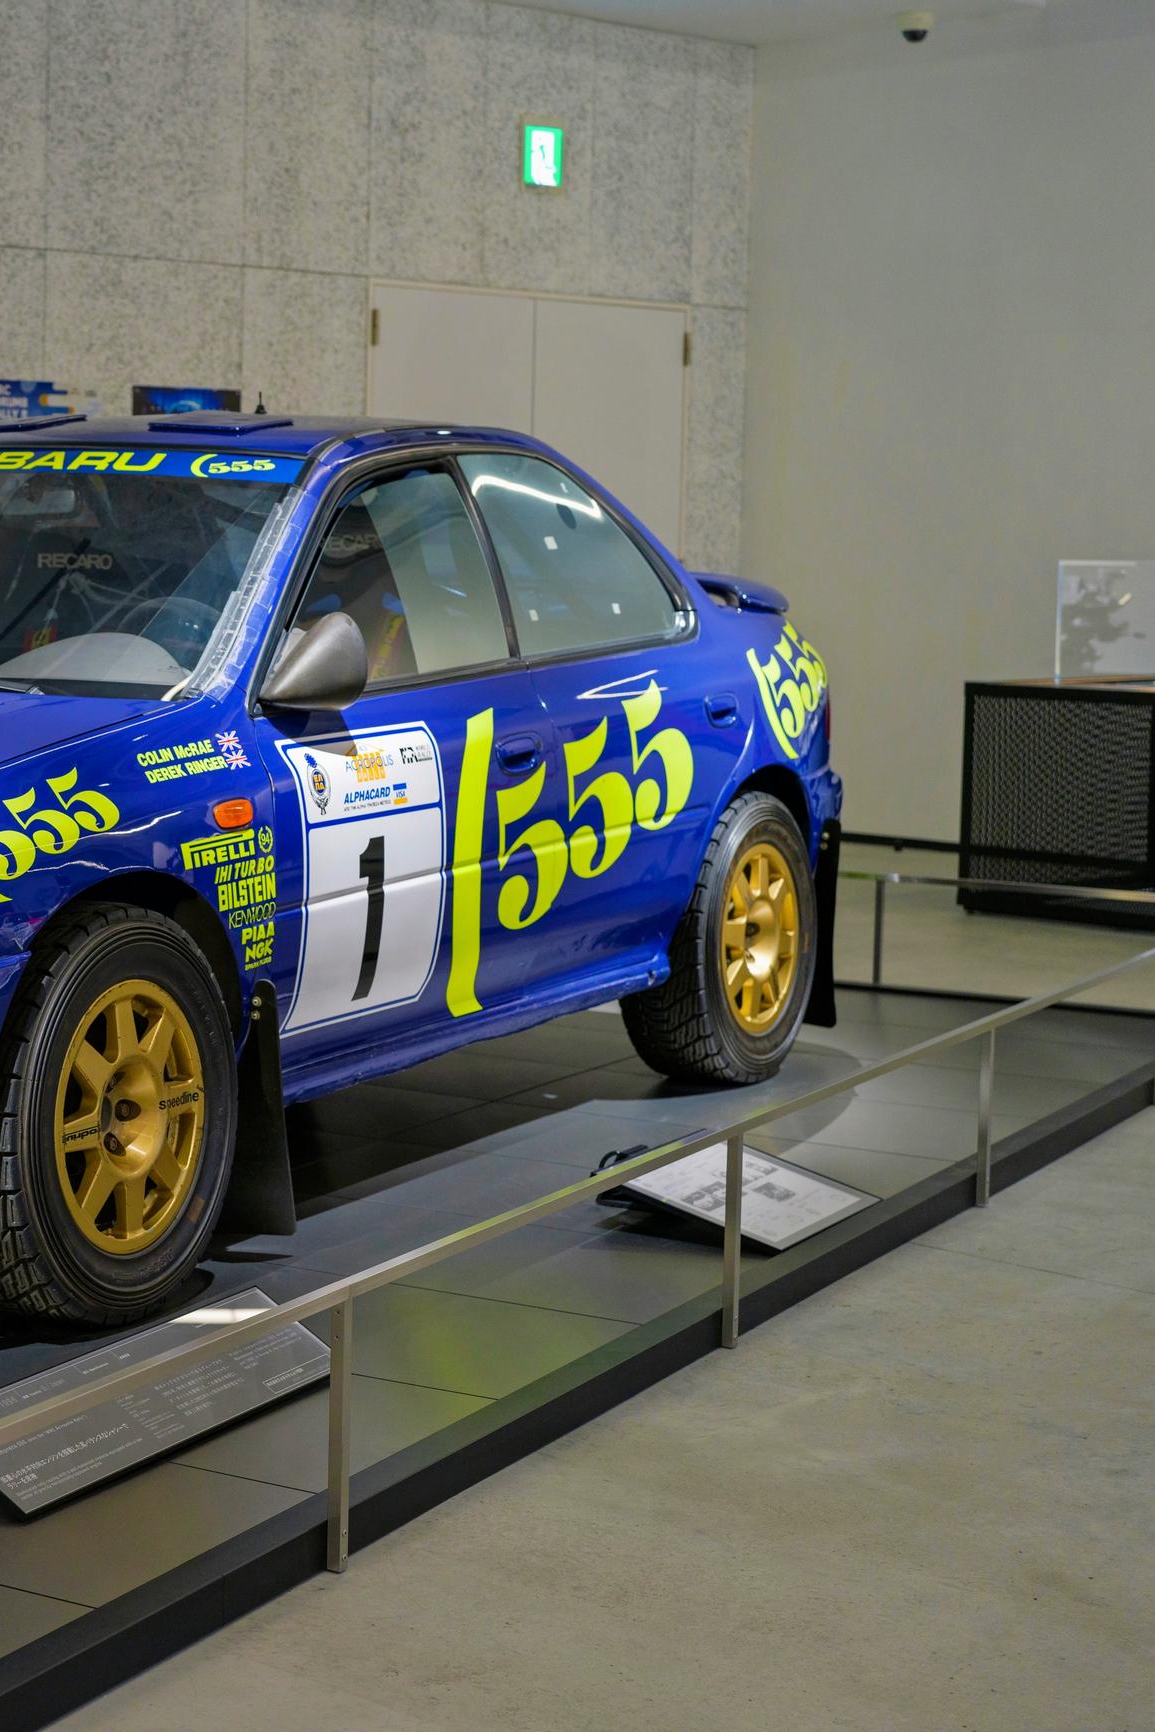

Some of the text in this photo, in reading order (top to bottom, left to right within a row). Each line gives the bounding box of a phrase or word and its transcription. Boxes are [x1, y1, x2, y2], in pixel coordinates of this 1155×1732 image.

[37, 552, 113, 570] RECARO
[136, 739, 215, 767] COLIN McRAE
[345, 755, 394, 773] ACROPOLIS
[145, 755, 229, 784] DEREK RINGER
[344, 786, 391, 804] ALPHACARD
[395, 791, 406, 799] VISA
[496, 679, 694, 931] 555
[180, 828, 255, 871] PIRELLI
[214, 855, 275, 885] IHI TURBO
[217, 872, 277, 912] BILSTEIN
[228, 901, 277, 929] KENWOOD
[351, 835, 386, 1001] 1
[241, 921, 275, 945] PIAA
[245, 938, 274, 963] NGK
